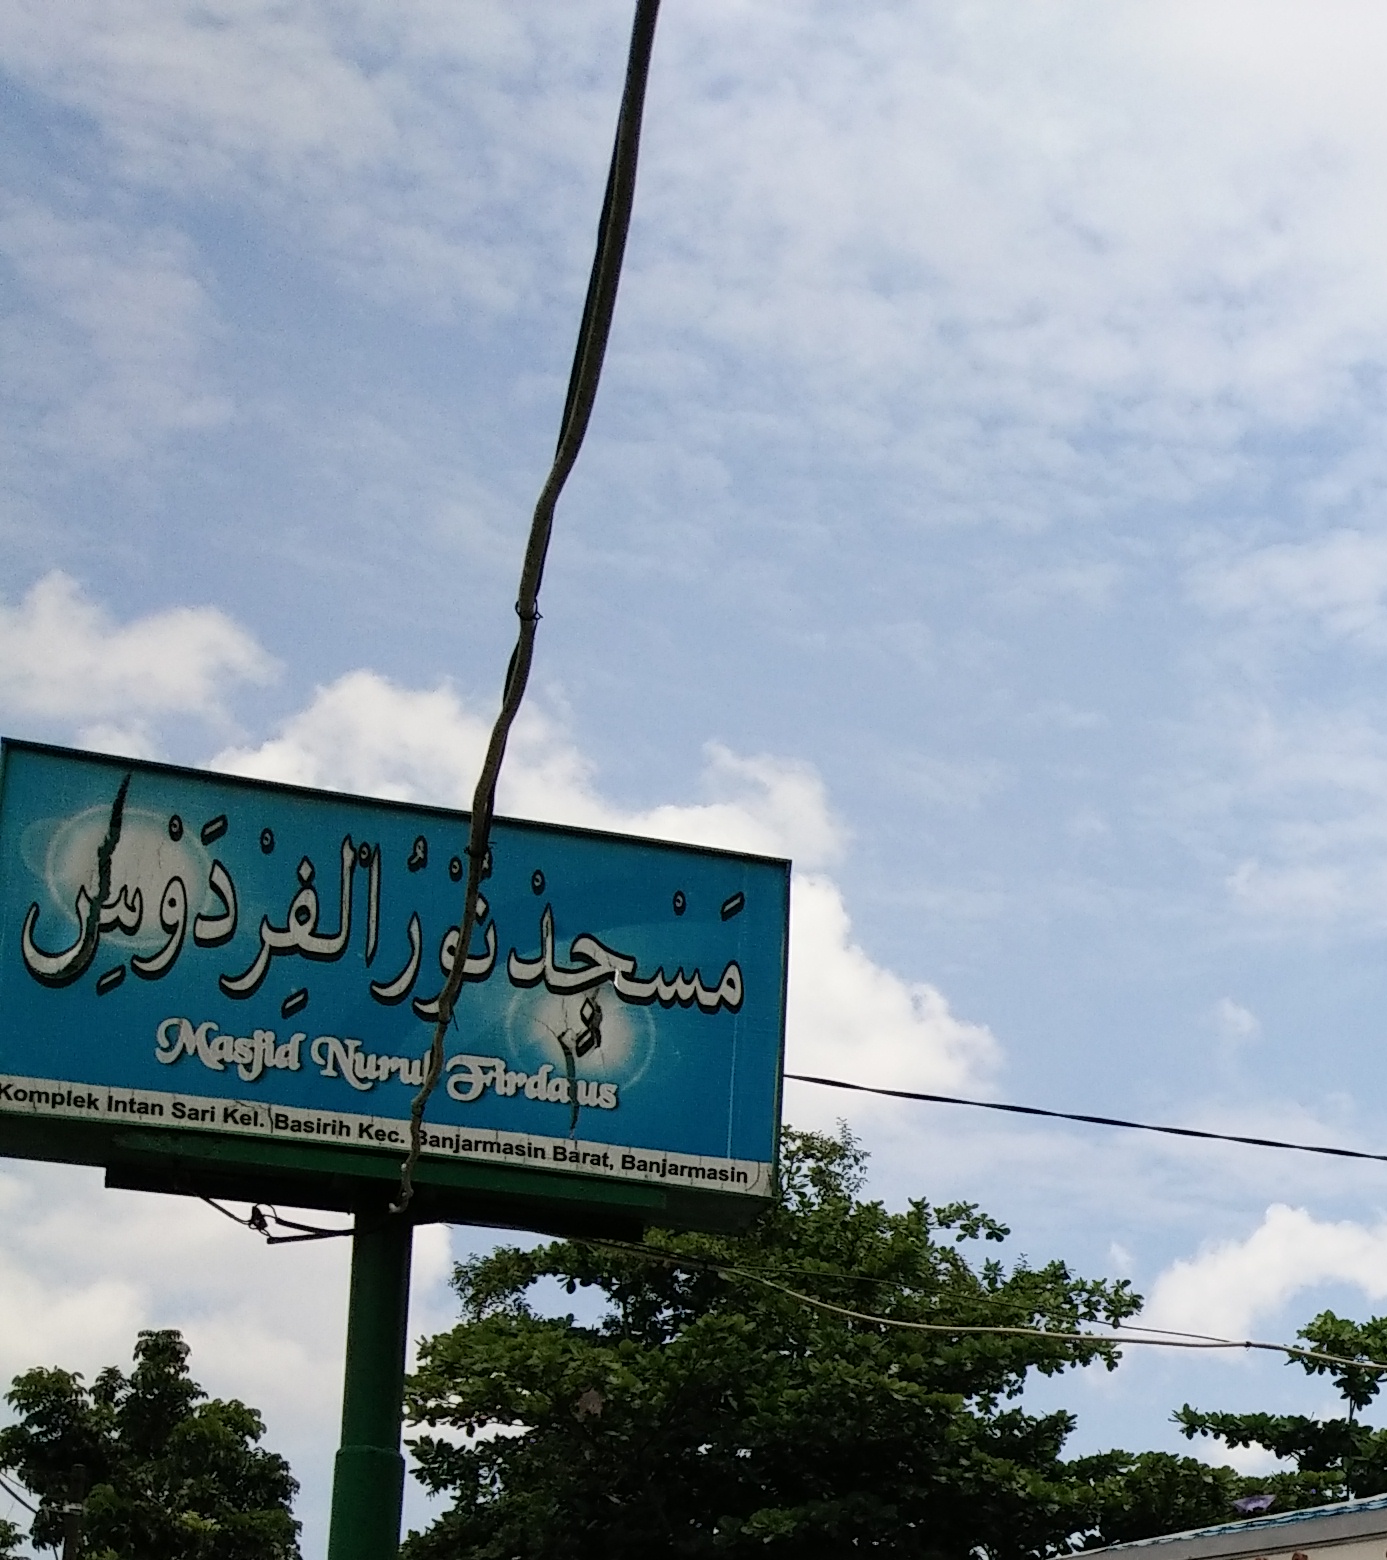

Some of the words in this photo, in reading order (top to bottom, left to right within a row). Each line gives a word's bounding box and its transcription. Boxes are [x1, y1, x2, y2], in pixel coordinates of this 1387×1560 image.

[155, 1017, 306, 1082] Masjid
[310, 1035, 436, 1091] Nurul
[445, 1053, 619, 1110] Firdaus
[0, 1083, 100, 1111] Komplek
[107, 1095, 165, 1117] Intan
[171, 1102, 216, 1124] Sari
[223, 1108, 265, 1129] Kel.
[274, 1113, 351, 1138] Basirih
[358, 1122, 406, 1144] Kec.
[552, 1145, 614, 1171] Barat,
[621, 1155, 749, 1184] Banjarmasin
